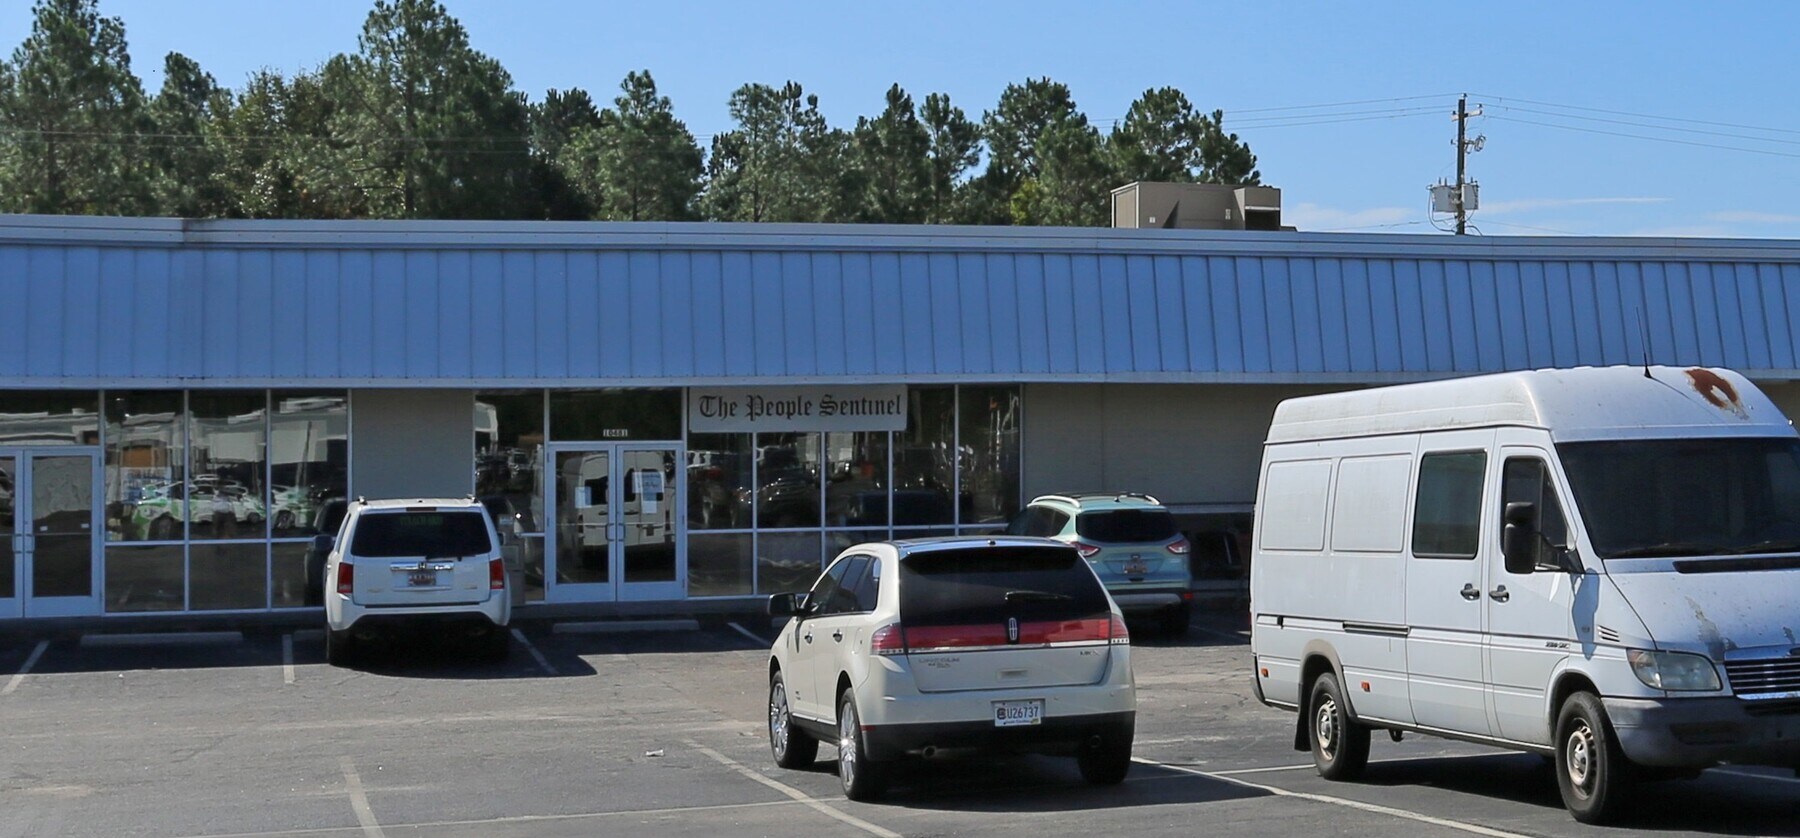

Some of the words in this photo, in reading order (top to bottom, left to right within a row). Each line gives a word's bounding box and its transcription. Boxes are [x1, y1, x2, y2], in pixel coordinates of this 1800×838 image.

[699, 394, 738, 421] The
[745, 394, 812, 421] People
[818, 393, 902, 418] Sentinel
[1007, 706, 1039, 718] U26737
